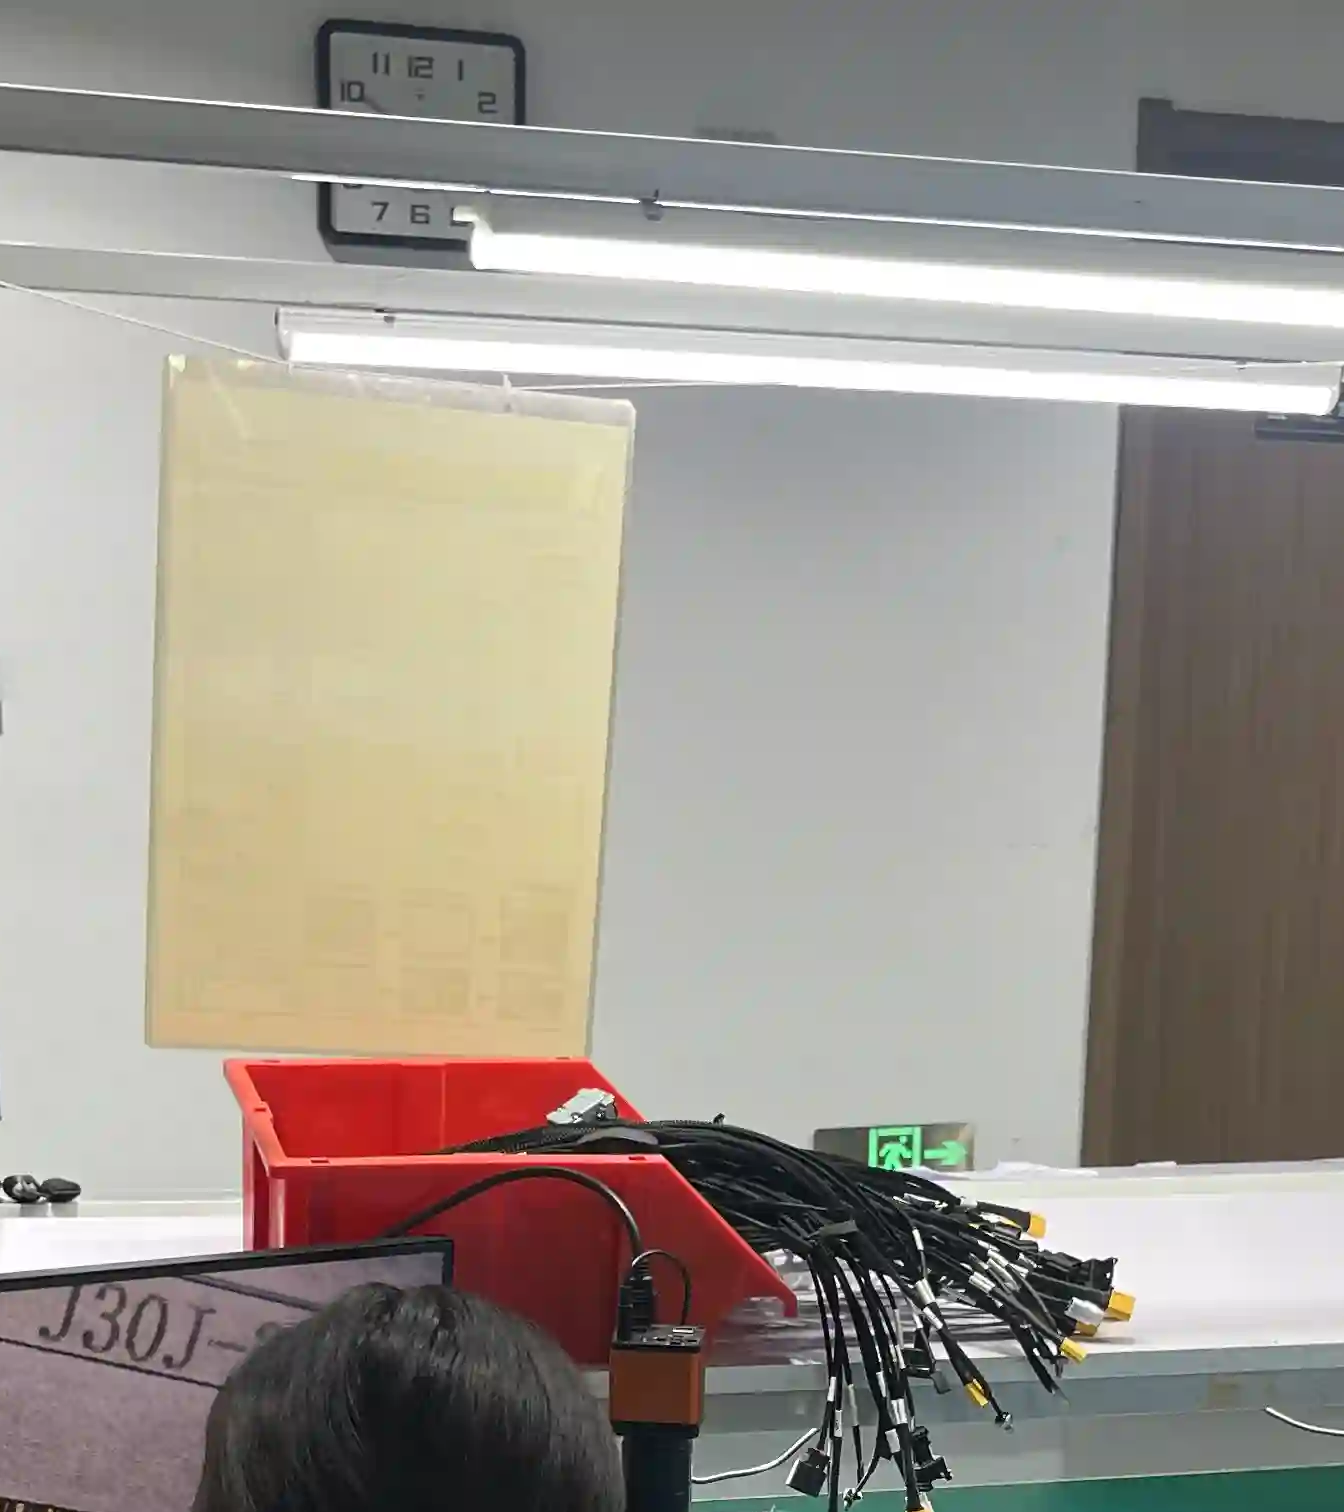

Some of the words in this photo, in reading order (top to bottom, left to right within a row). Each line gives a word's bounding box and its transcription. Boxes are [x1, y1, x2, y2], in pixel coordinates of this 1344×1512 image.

[372, 52, 391, 76] 11
[407, 55, 435, 79] 12
[458, 60, 464, 81] 1
[339, 80, 365, 103] 10
[478, 92, 499, 115] 2
[372, 202, 390, 222] 7
[411, 205, 431, 225] 6
